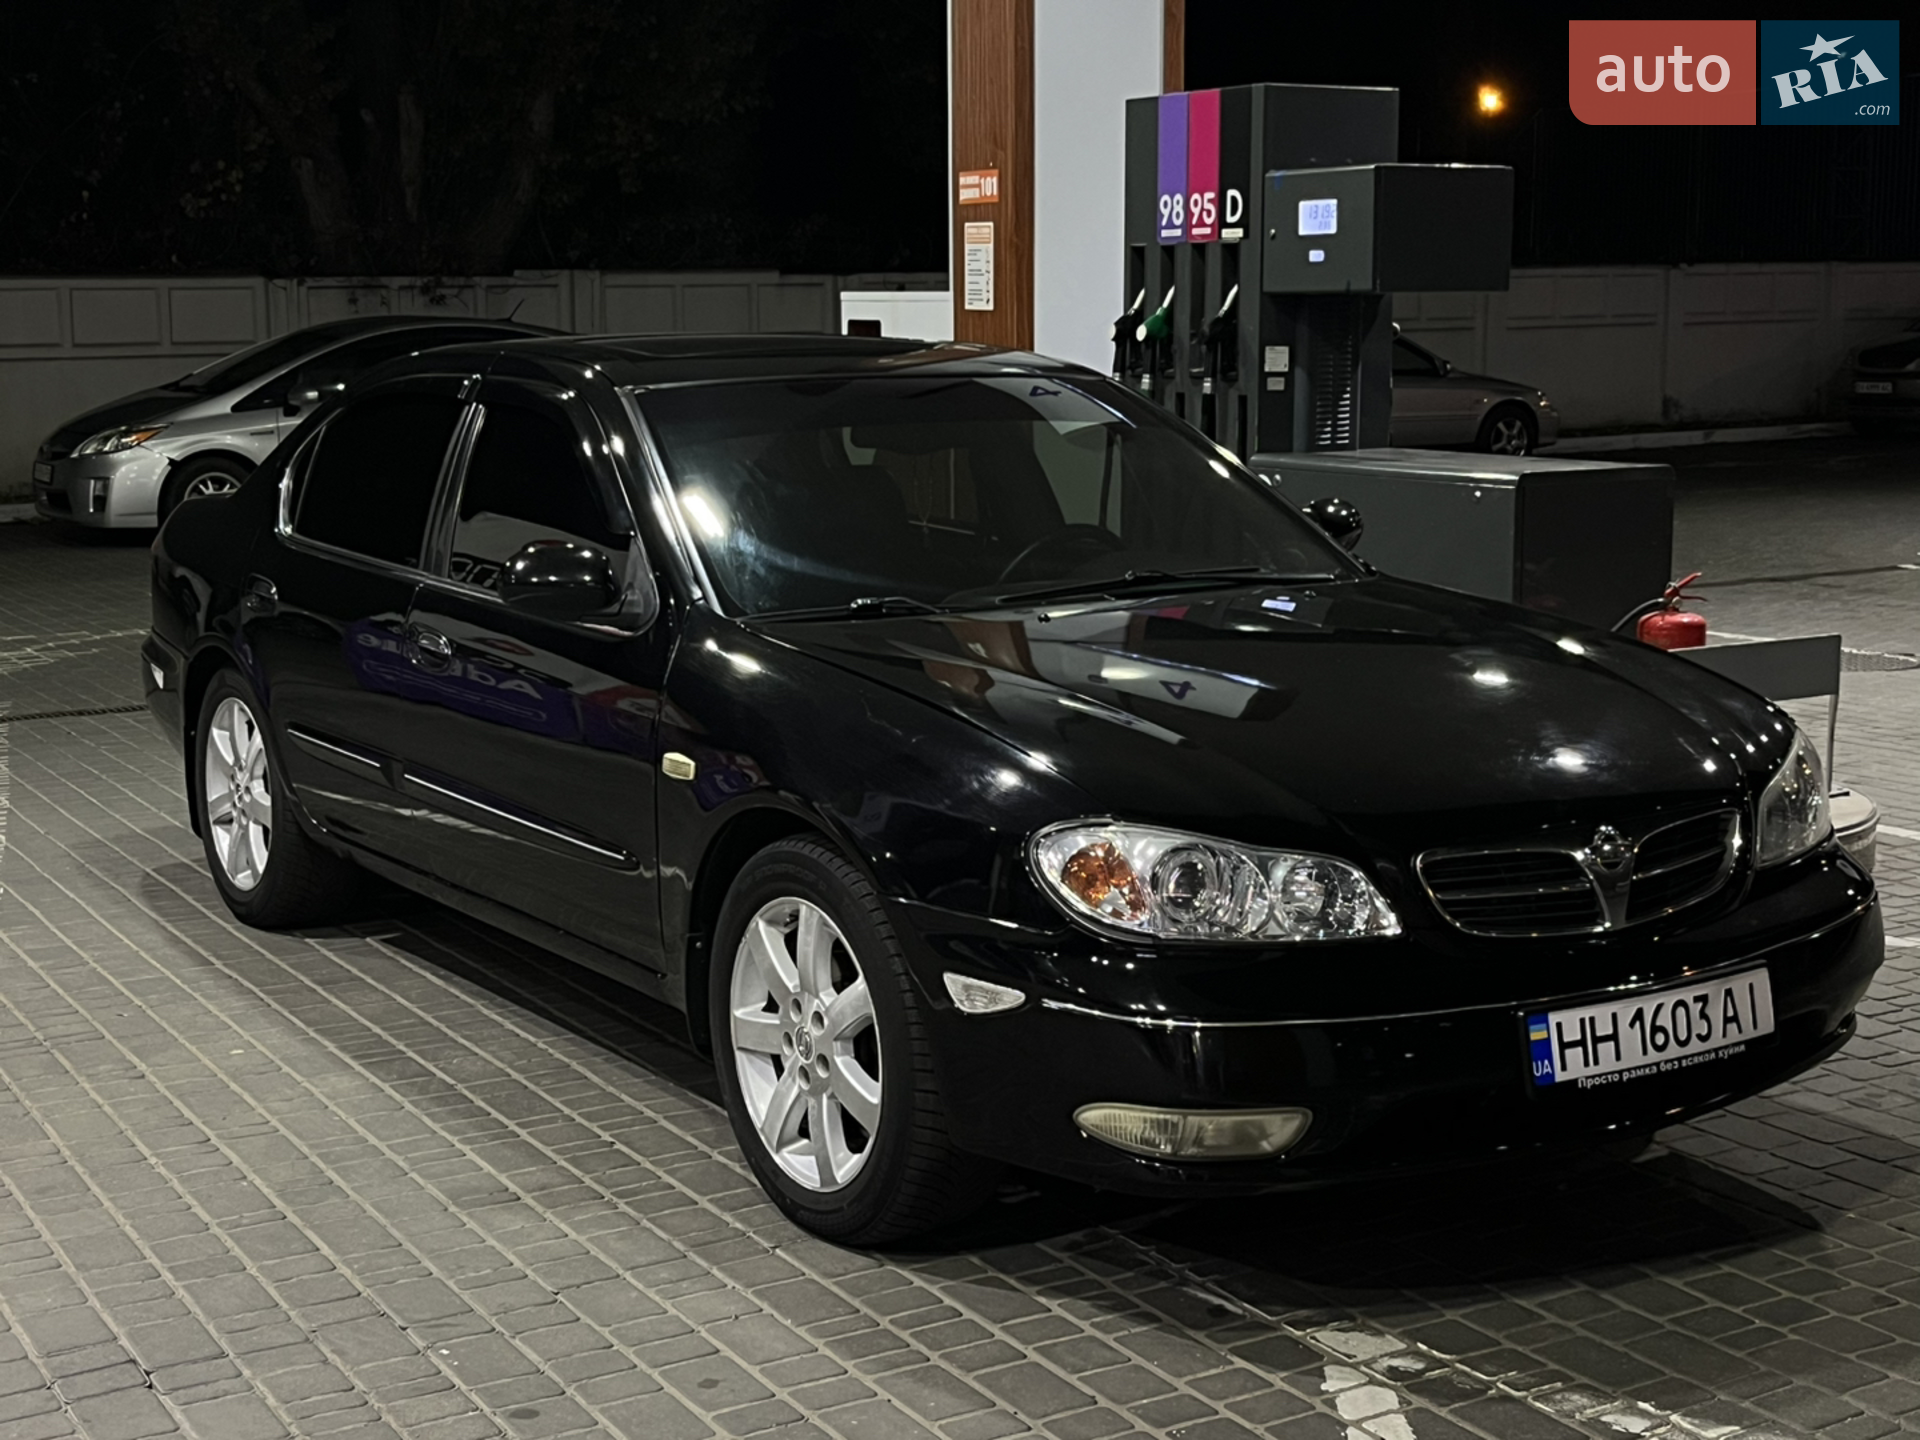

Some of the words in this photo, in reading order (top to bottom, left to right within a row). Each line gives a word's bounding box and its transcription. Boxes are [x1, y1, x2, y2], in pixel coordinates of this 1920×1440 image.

[980, 176, 997, 197] 101
[1160, 193, 1184, 227] 98
[1189, 192, 1216, 225] 95
[1226, 188, 1243, 223] D
[1533, 1059, 1552, 1077] UA
[1577, 1072, 1620, 1089] Просто
[1622, 1066, 1657, 1082] рамка
[1659, 1060, 1679, 1072] без
[1681, 1051, 1716, 1067] всякой
